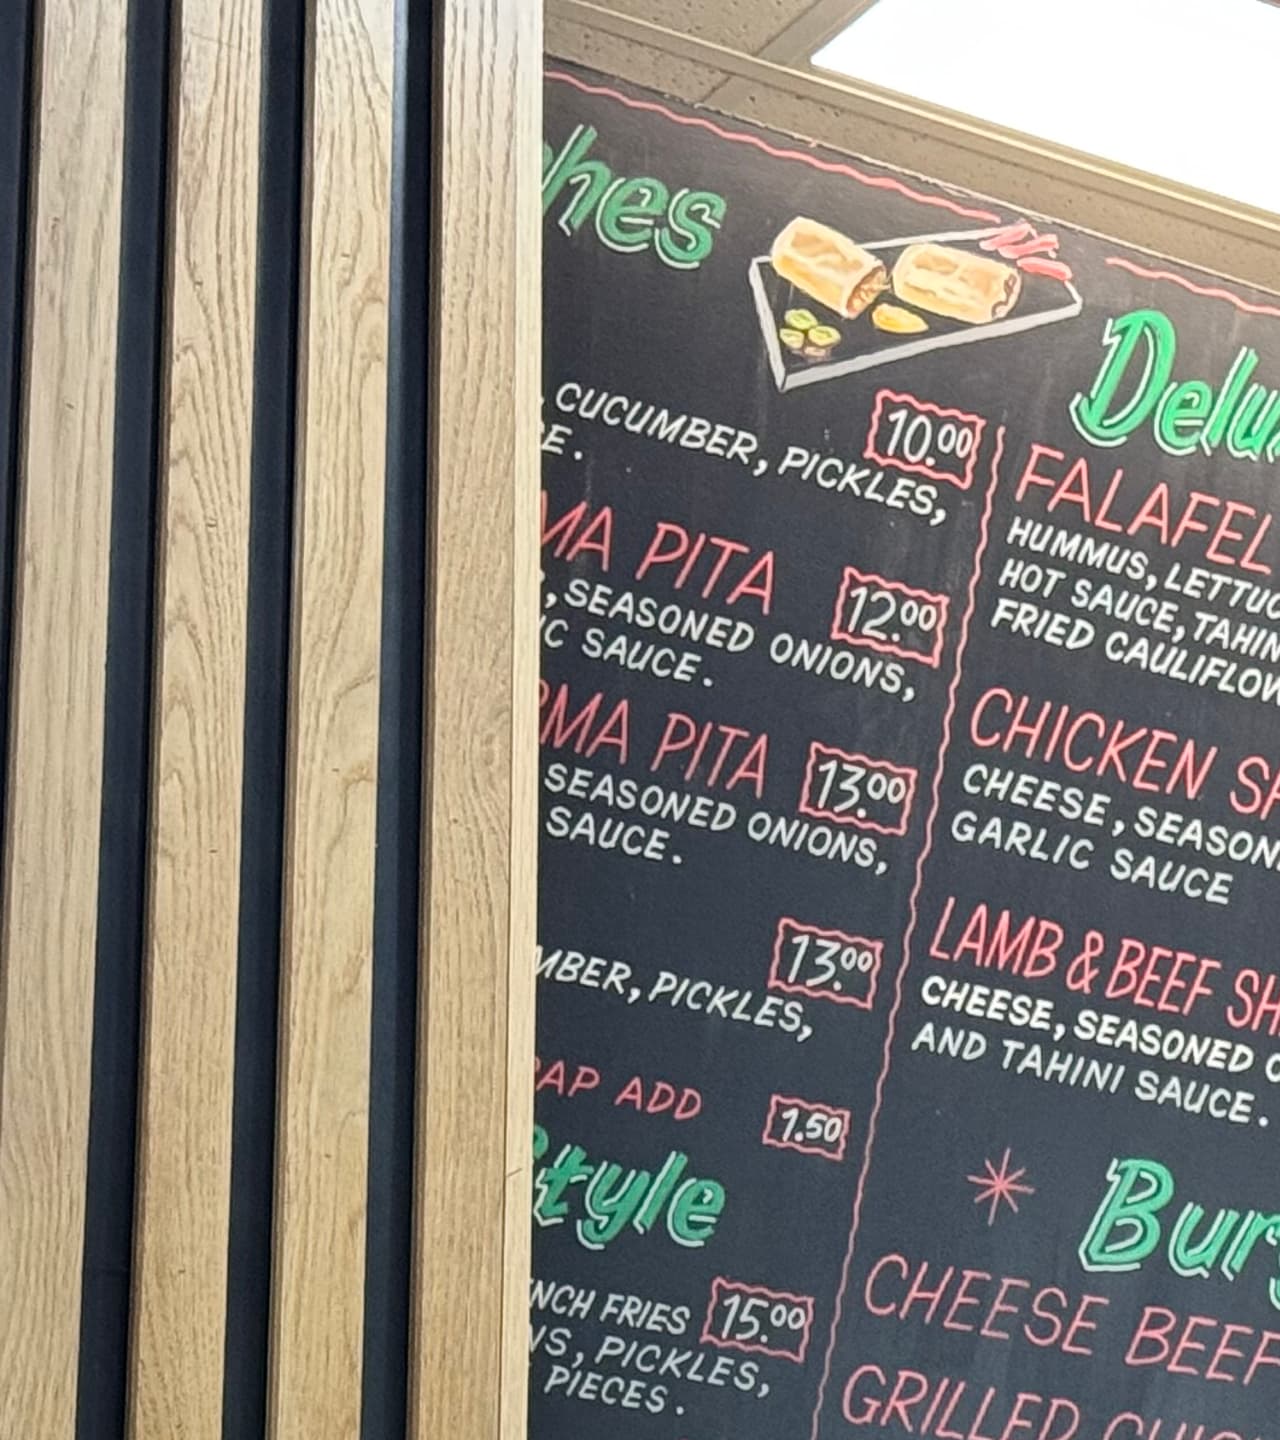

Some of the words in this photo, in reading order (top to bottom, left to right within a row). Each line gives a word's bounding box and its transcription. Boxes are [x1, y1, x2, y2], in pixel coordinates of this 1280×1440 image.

[555, 381, 769, 477] CUCUMBER,
[776, 445, 947, 527] PICKLES,
[1014, 442, 1273, 576] FALAFEL
[635, 521, 775, 616] PITA
[1005, 515, 1159, 592] HUMMUS,
[563, 578, 756, 653] SEASONED
[768, 631, 916, 703] ONIONS,
[990, 596, 1096, 651] FRIED
[997, 557, 1067, 599] HOT
[1069, 577, 1187, 645] SAUCE,
[580, 626, 714, 688] SAUCE.
[649, 711, 769, 799] PITA
[969, 686, 1219, 801] CHICKEN
[547, 767, 738, 832] SEASONED
[746, 810, 888, 877] ONIONS,
[547, 805, 683, 865] SAUCE.
[962, 762, 1126, 838] CHEESE,
[950, 809, 1095, 871] GARLIC
[1109, 846, 1235, 906] SAUCE
[928, 895, 1065, 979] LAMB
[1065, 929, 1106, 995] &
[1104, 937, 1223, 1016] BEEF
[647, 970, 813, 1043] PICKLES,
[920, 974, 1067, 1042] CHEESE,
[1072, 1008, 1255, 1074] SEASONED
[614, 1075, 703, 1121] ADD
[910, 1020, 988, 1062] AND
[1001, 1038, 1126, 1094] TAHINI
[1133, 1068, 1270, 1128] SAUCE.
[598, 1292, 692, 1336] FRIES
[863, 1252, 1111, 1356] CHEESE
[544, 1364, 685, 1416] PIECES.
[593, 1334, 771, 1399] PICKLES,
